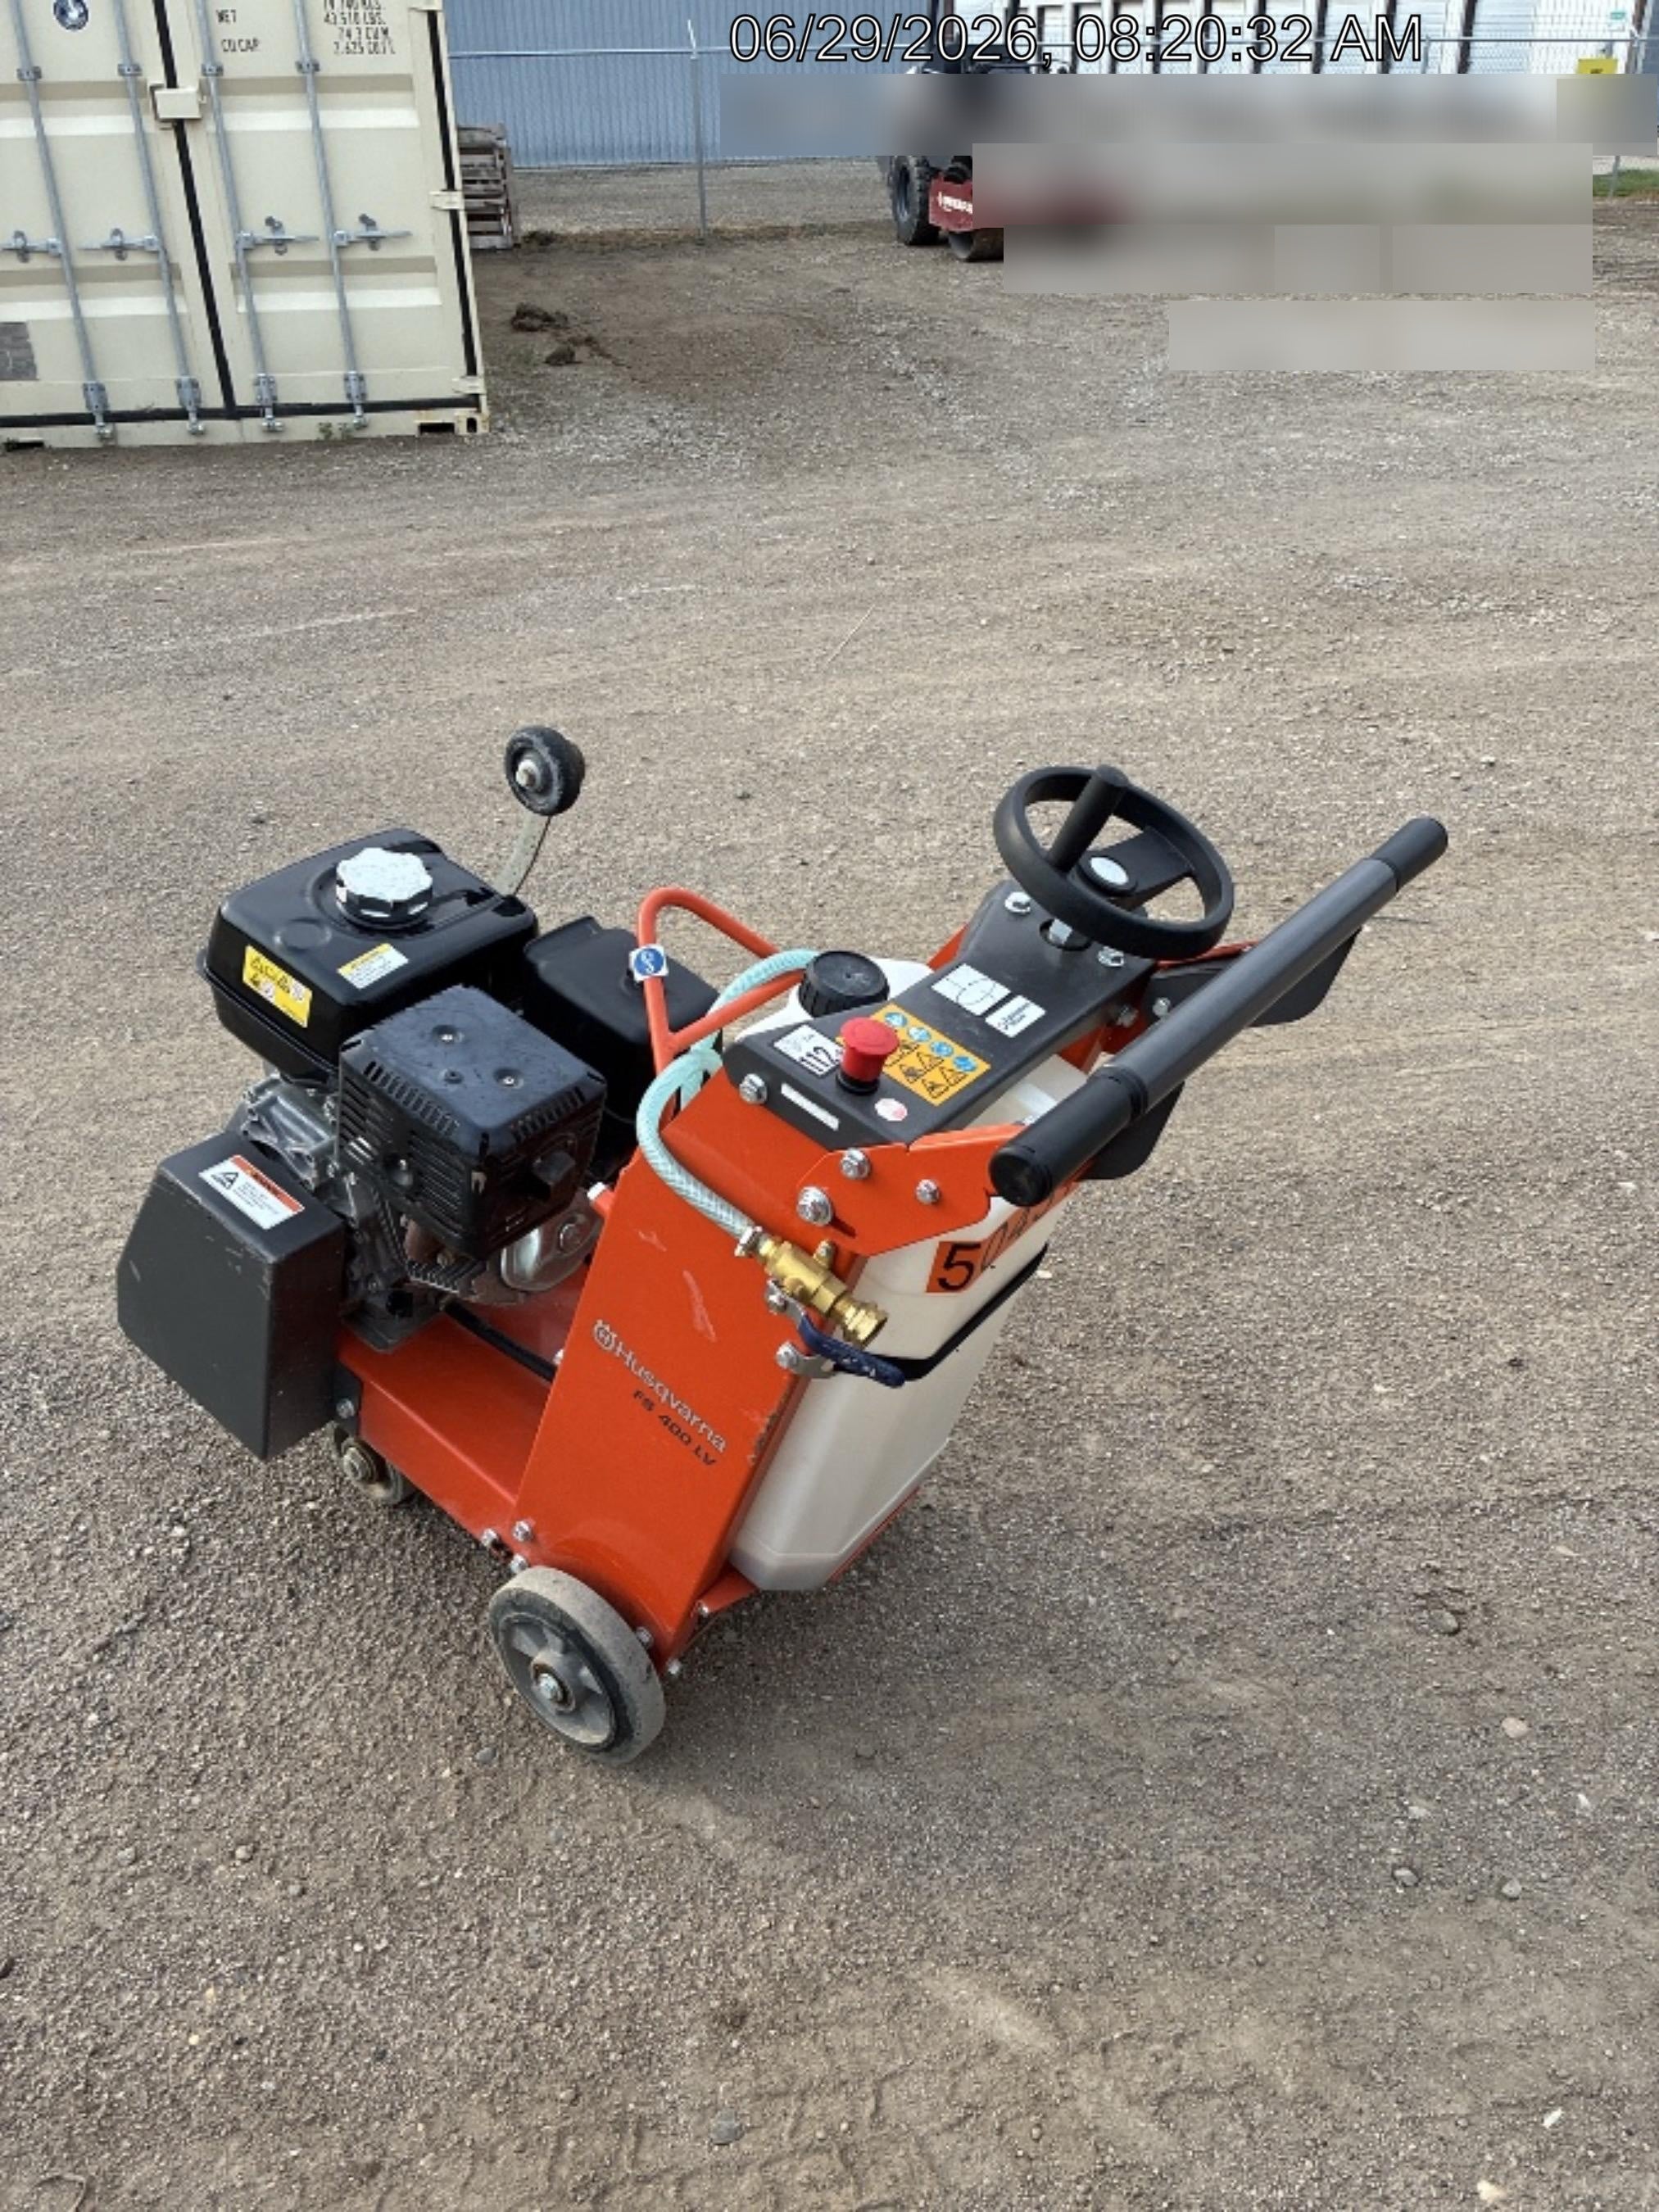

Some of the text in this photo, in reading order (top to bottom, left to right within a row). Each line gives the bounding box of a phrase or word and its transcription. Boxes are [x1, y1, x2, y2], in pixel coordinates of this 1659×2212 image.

[615, 1341, 727, 1453] Husqvarna
[632, 1389, 718, 1466] FS 400 LV
